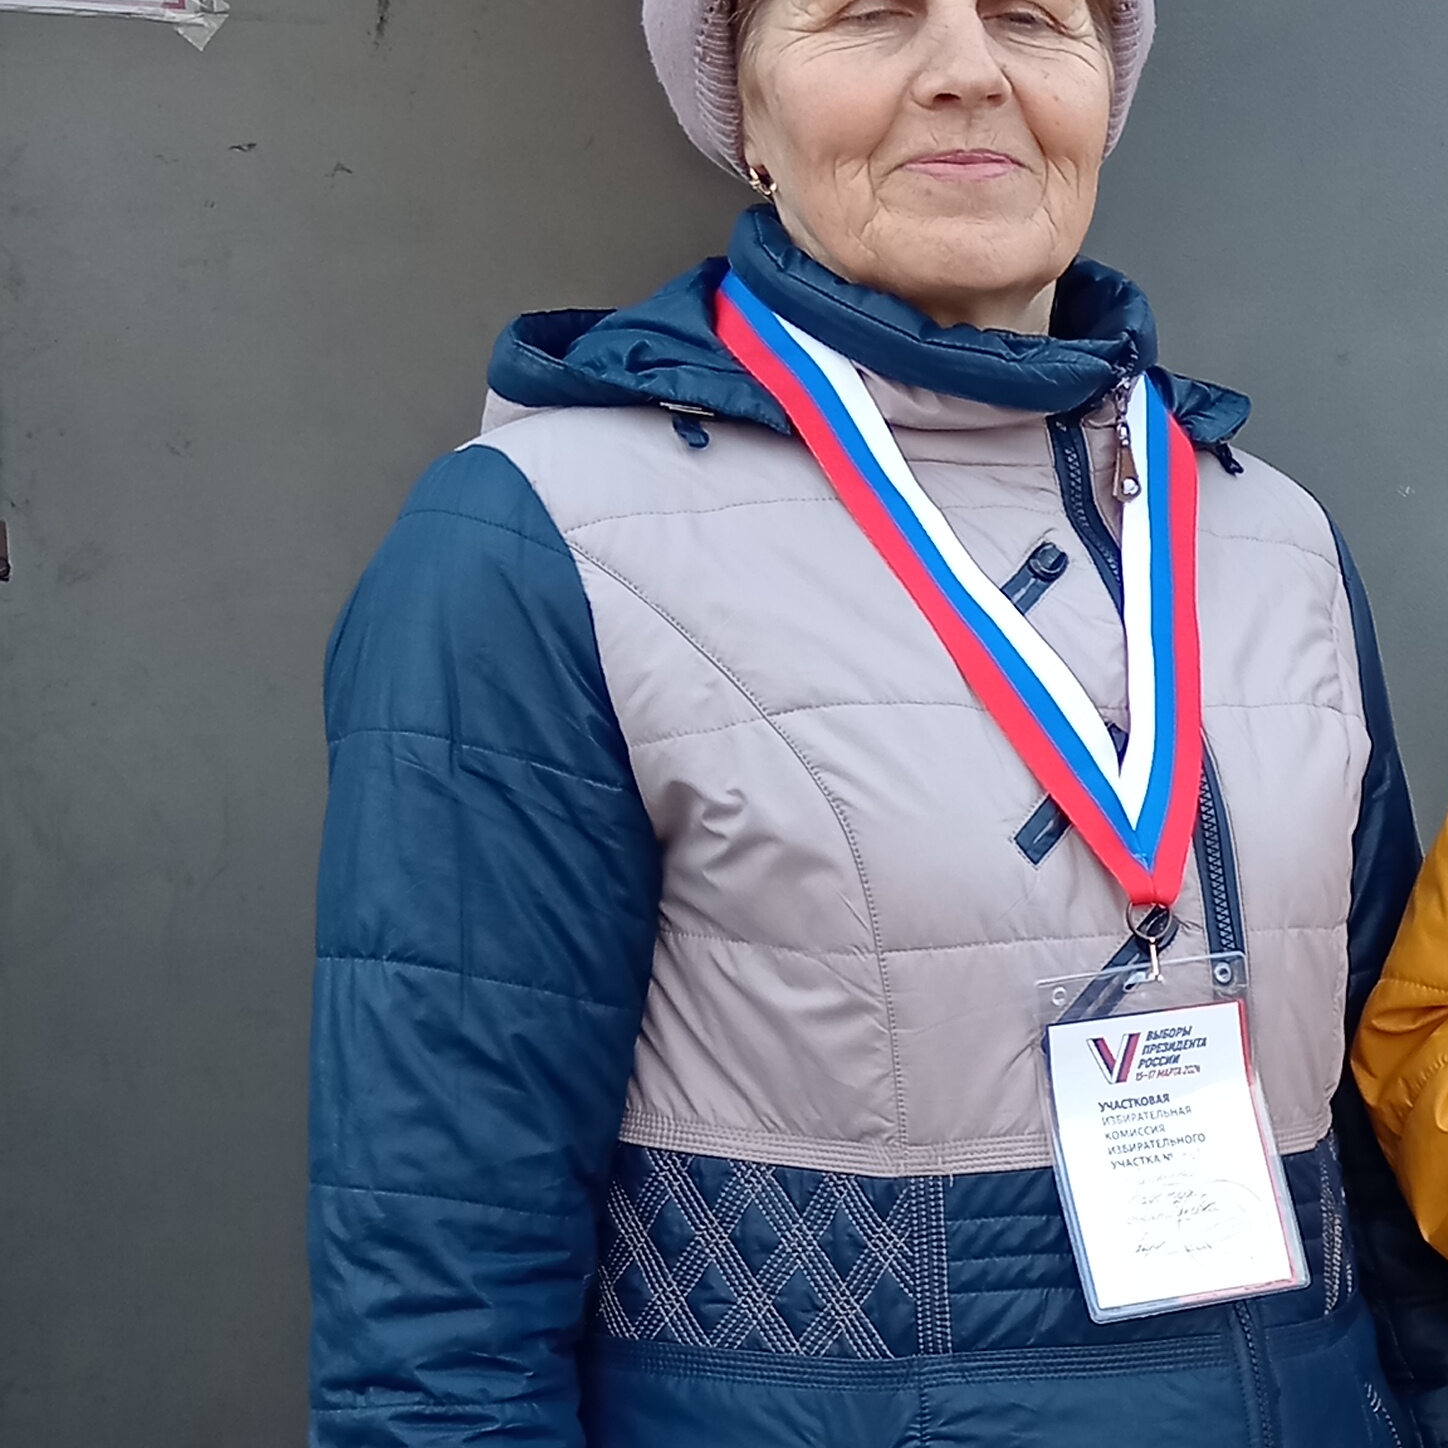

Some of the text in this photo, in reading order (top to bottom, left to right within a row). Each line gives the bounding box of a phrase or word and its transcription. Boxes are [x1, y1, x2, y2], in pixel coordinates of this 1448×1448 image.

[1146, 1025, 1193, 1041] ВЫБОРЫ
[1142, 1037, 1207, 1055] ПРЕЗИДЕНТА
[1137, 1054, 1181, 1069] РОССИИ
[1098, 1093, 1170, 1112] УЧАСТКОВАЯ
[1102, 1105, 1192, 1126] ИЗБИРАТЕЛЬНАЯ
[1105, 1124, 1166, 1140] КОМИССИЯ
[1108, 1133, 1206, 1155] ИЗБИРАТЕЛЬНОГО
[1111, 1154, 1161, 1170] УЧАСТКА
